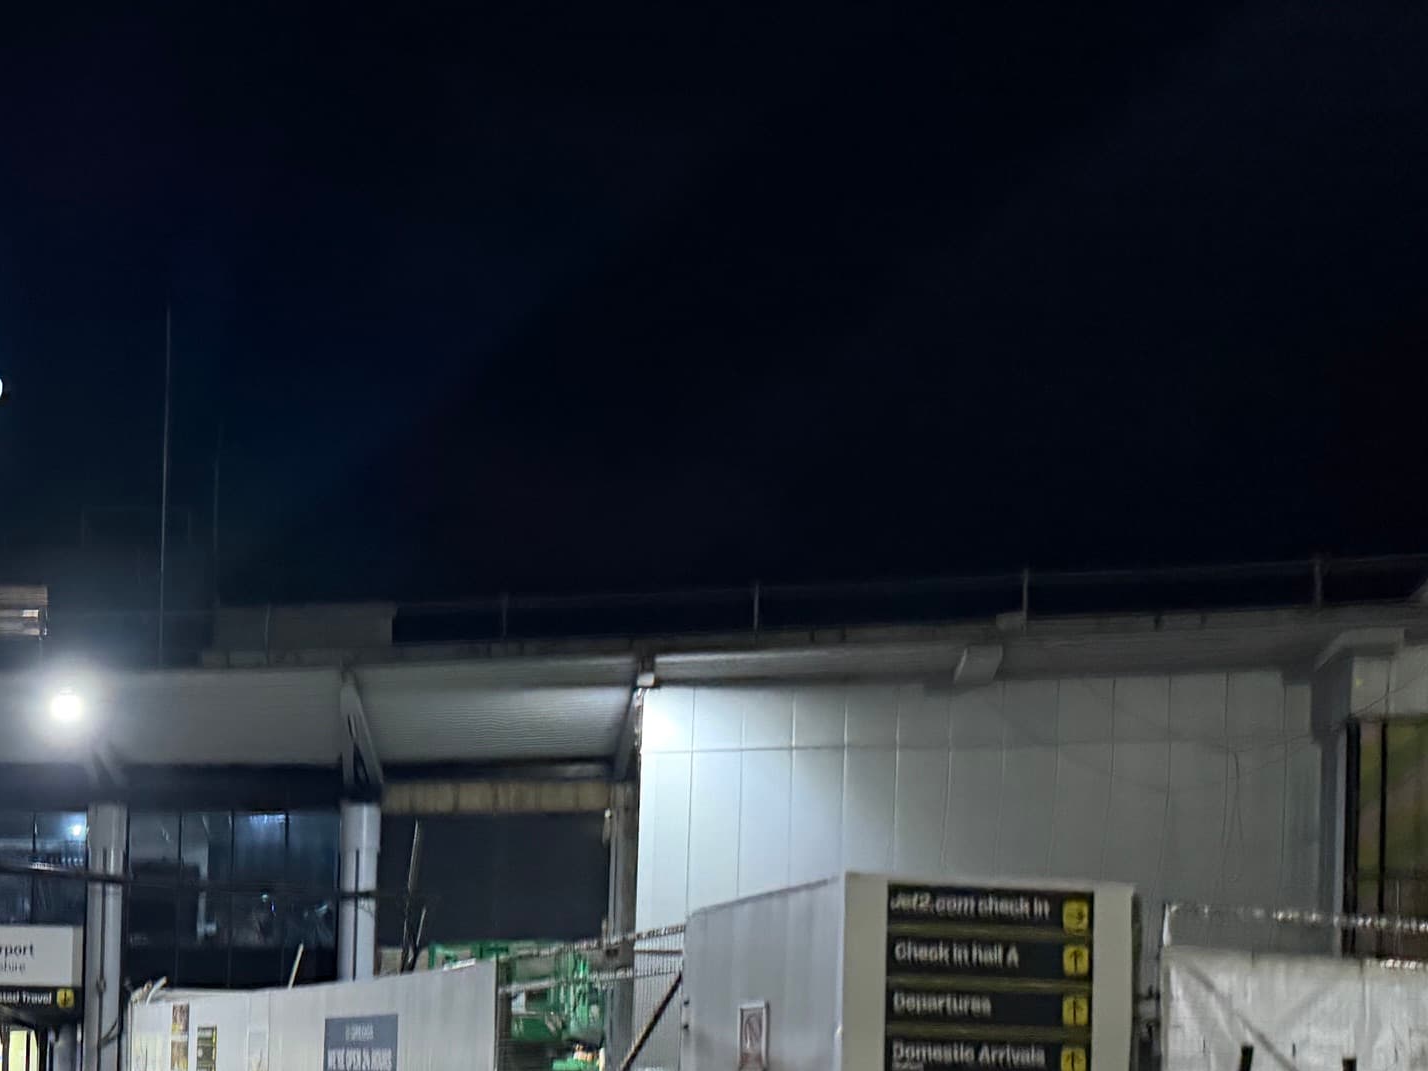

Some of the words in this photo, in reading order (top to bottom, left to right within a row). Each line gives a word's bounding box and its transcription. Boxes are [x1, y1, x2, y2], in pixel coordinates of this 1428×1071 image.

[895, 940, 949, 965] Check
[953, 942, 969, 967] in
[972, 942, 1003, 967] hall
[1006, 944, 1020, 968] A
[22, 989, 53, 1005] Travel
[893, 991, 992, 1018] Departures
[892, 1038, 975, 1065] Domestic
[978, 1043, 1047, 1068] Arrivals
